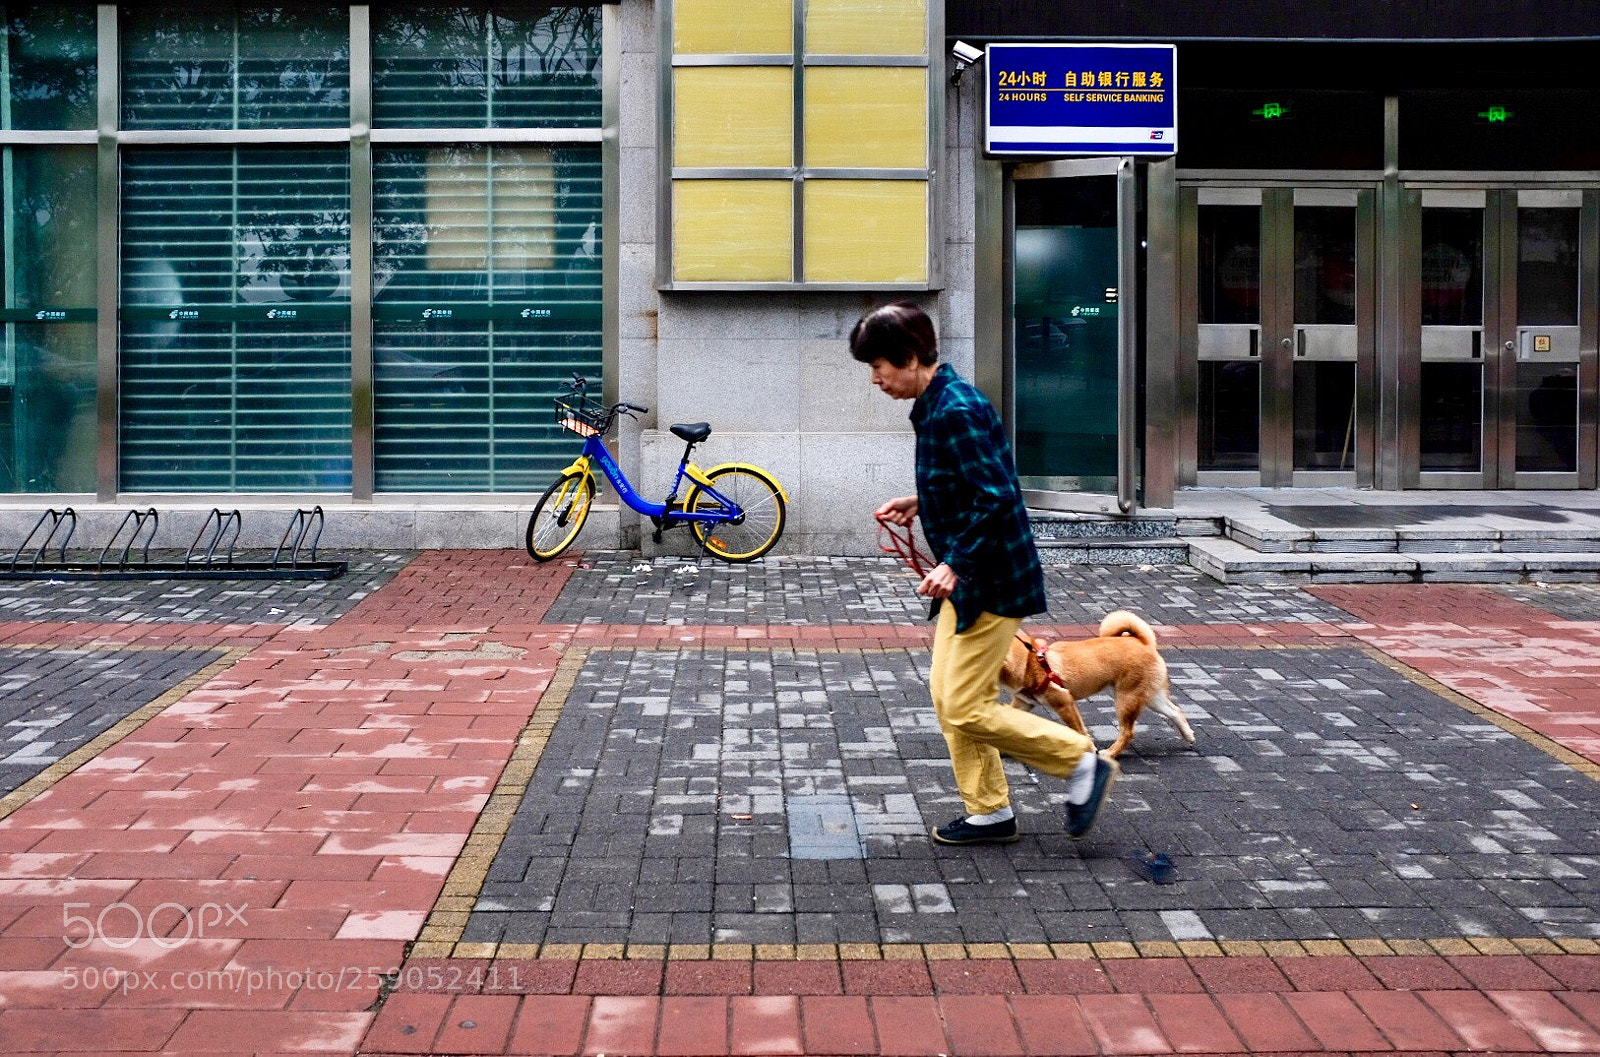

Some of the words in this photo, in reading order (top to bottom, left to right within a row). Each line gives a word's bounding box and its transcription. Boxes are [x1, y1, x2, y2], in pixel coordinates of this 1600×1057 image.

[998, 70, 1048, 87] 24小时
[1065, 70, 1164, 88] 自助银行服务
[998, 93, 1010, 102] 24
[1011, 93, 1047, 102] HOURS
[1063, 93, 1085, 102] SELF
[1086, 93, 1123, 103] SERVICE
[1123, 93, 1164, 103] BANKING
